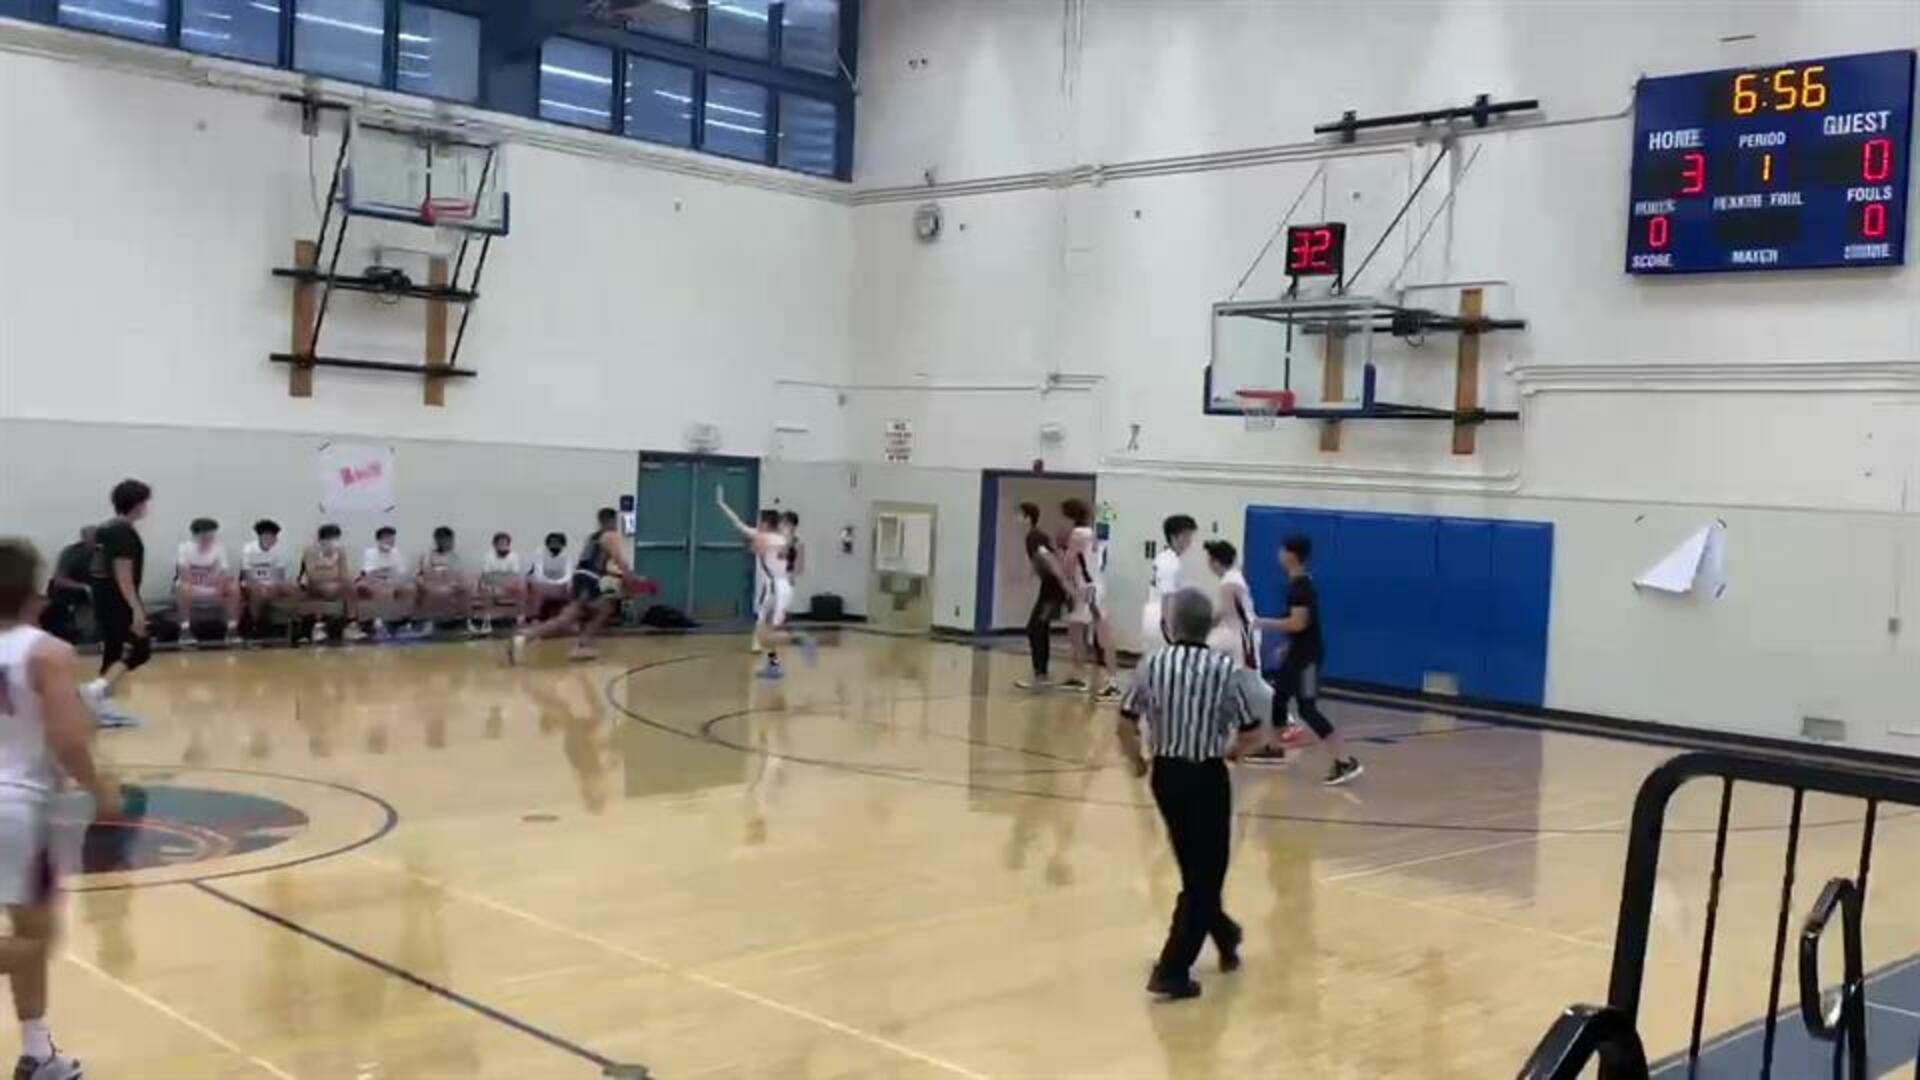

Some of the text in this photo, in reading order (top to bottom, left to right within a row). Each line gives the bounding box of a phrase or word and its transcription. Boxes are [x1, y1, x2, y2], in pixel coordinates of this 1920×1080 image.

[1733, 66, 1827, 115] 6:56
[1823, 110, 1892, 135] GUEST
[1649, 128, 1704, 150] HOME
[1739, 132, 1786, 148] PERIOD
[1682, 153, 1705, 194] 3
[1762, 153, 1771, 181] 1
[1863, 138, 1891, 182] 0
[1847, 185, 1893, 202] FOULS
[1649, 216, 1668, 247] 0
[1863, 203, 1886, 237] 0
[1290, 229, 1331, 269] 32
